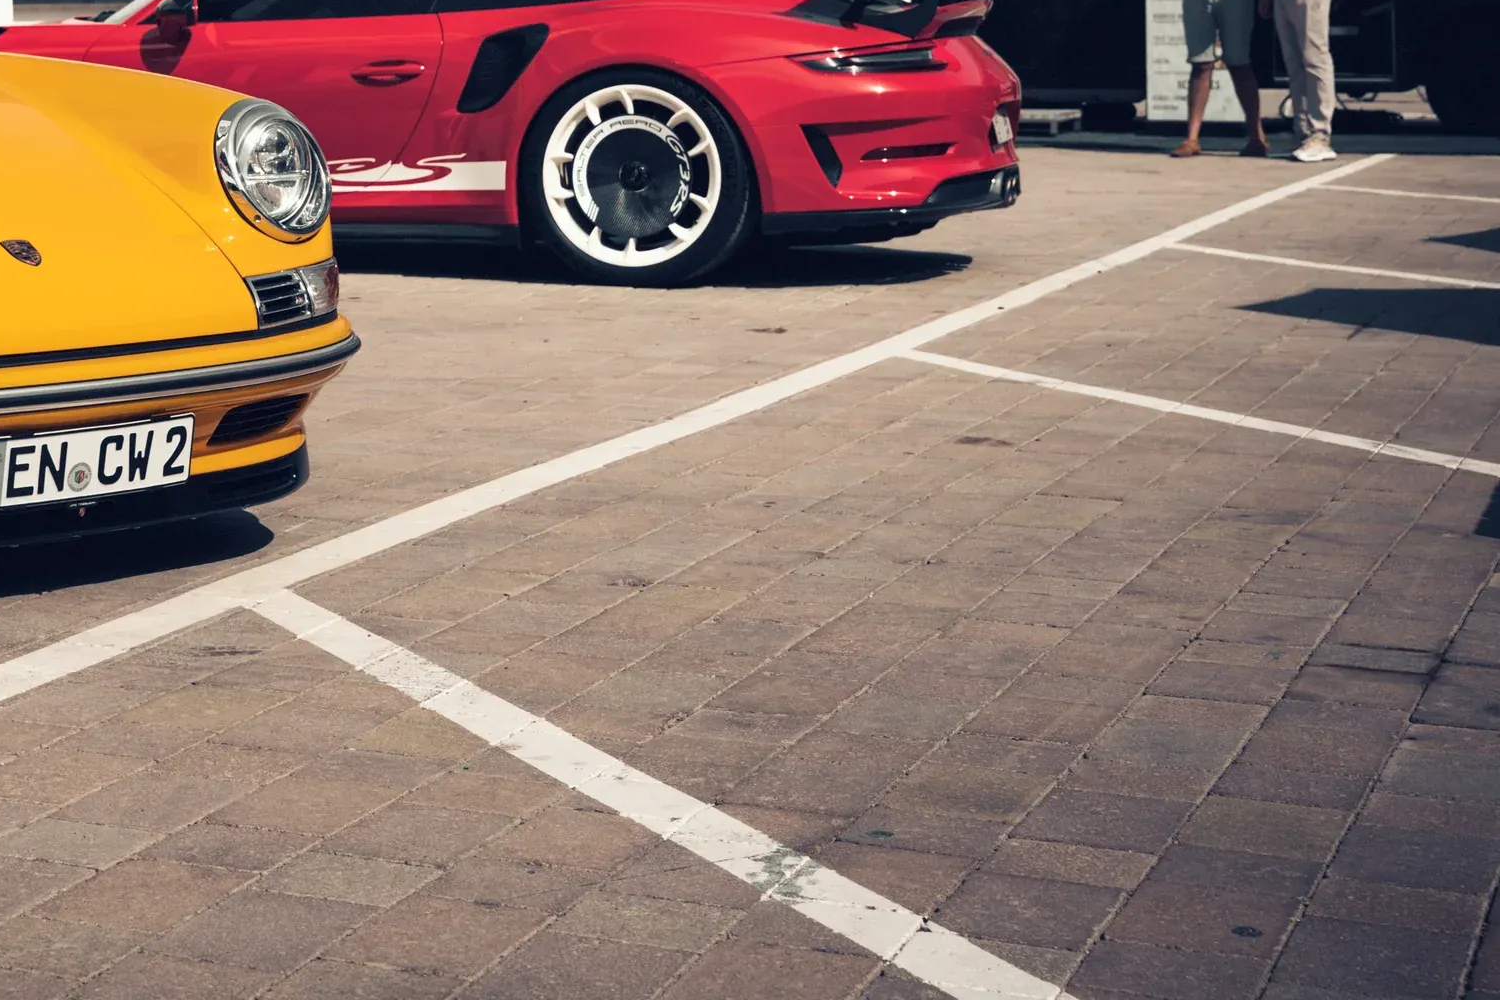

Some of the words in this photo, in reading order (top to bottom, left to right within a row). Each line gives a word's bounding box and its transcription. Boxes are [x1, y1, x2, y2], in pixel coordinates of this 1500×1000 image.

[6, 440, 68, 499] EN
[97, 429, 155, 486] CW
[162, 425, 188, 477] 2
